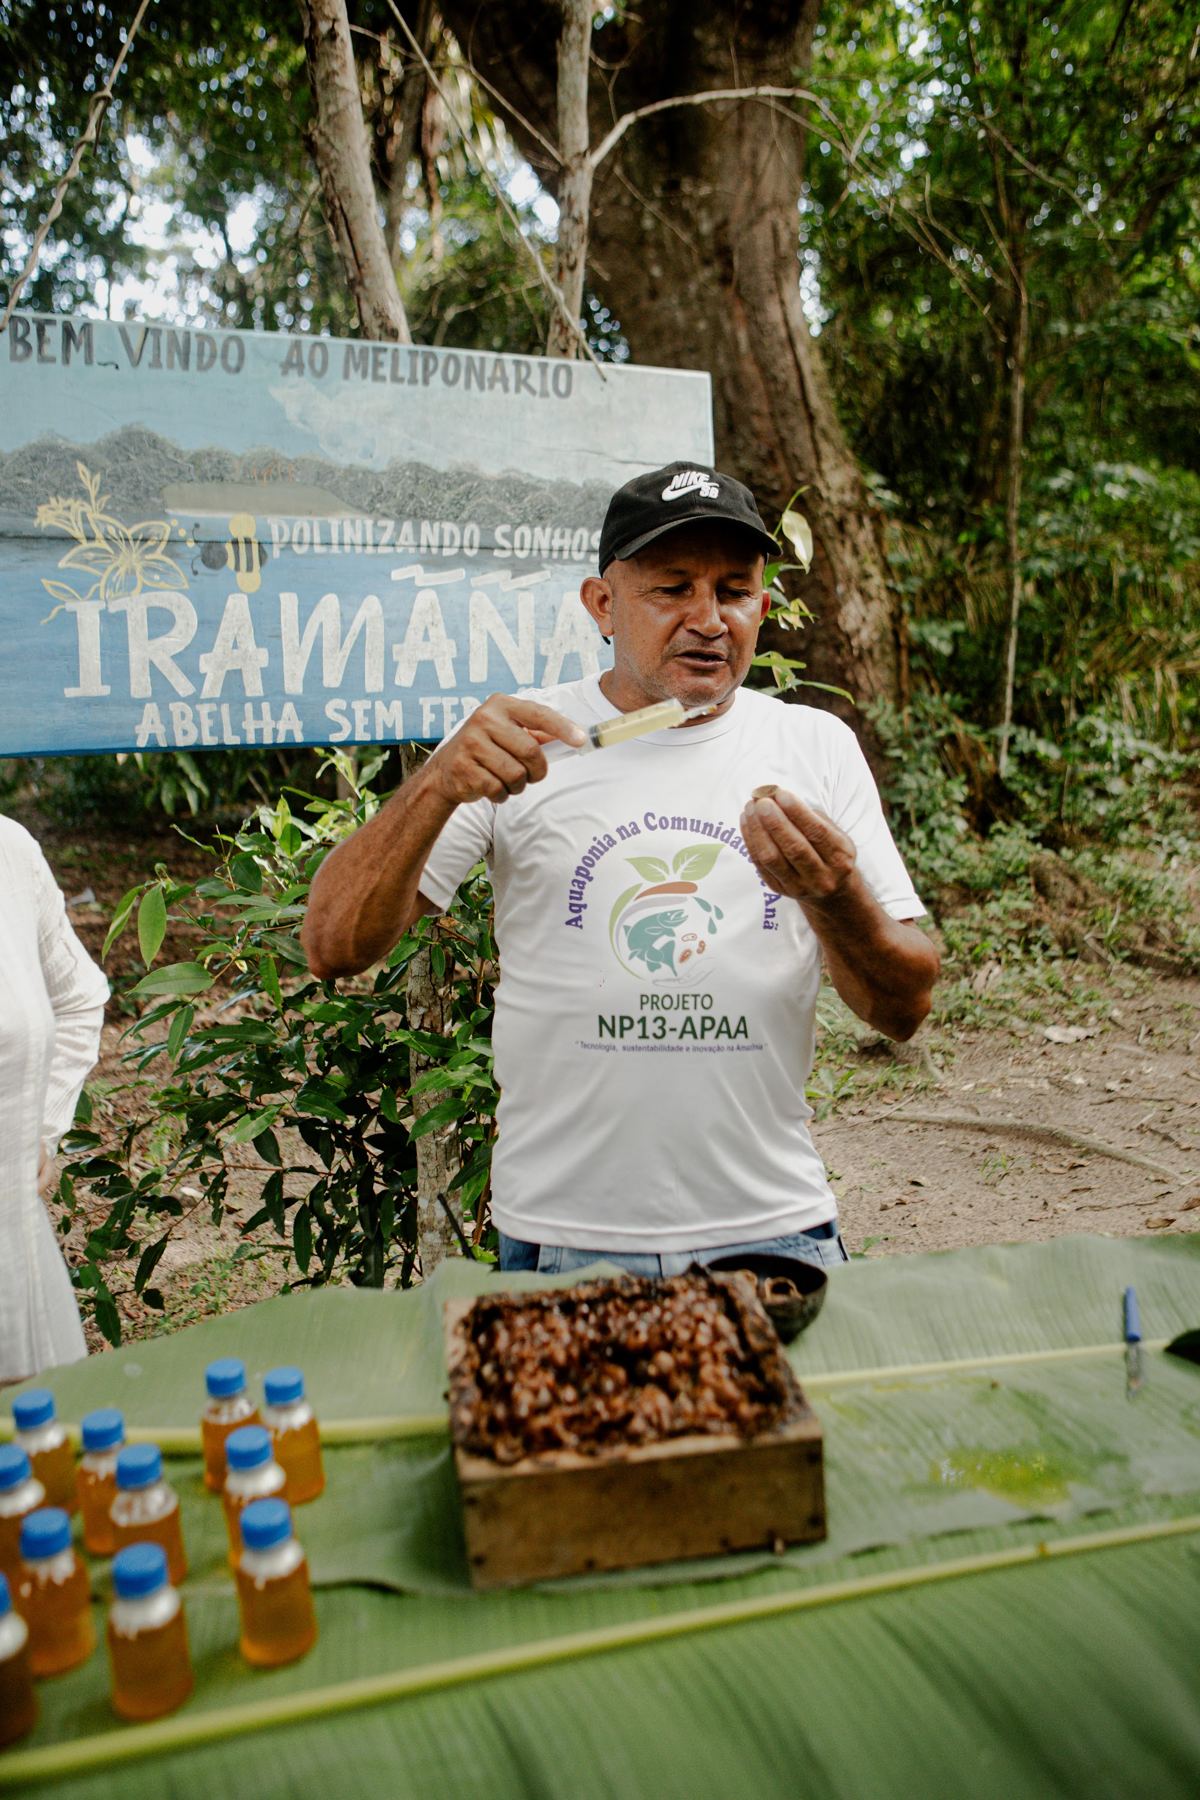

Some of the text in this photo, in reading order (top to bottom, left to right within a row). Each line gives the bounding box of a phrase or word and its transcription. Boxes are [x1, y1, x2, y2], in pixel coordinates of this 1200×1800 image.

[8, 315, 574, 399] BEM VINDO AO MELIPONARIO
[670, 471, 710, 490] NIKE
[267, 517, 481, 559] POLINIZANDO
[134, 701, 304, 748] ABELHA
[324, 698, 403, 742] SEM
[565, 833, 617, 931] Aquaponia
[615, 821, 641, 841] na
[643, 811, 753, 863] Comunida
[639, 993, 713, 1011] PROJETO
[598, 1015, 749, 1040] NP13-APAA
[622, 1043, 684, 1052] sustentabilidade
